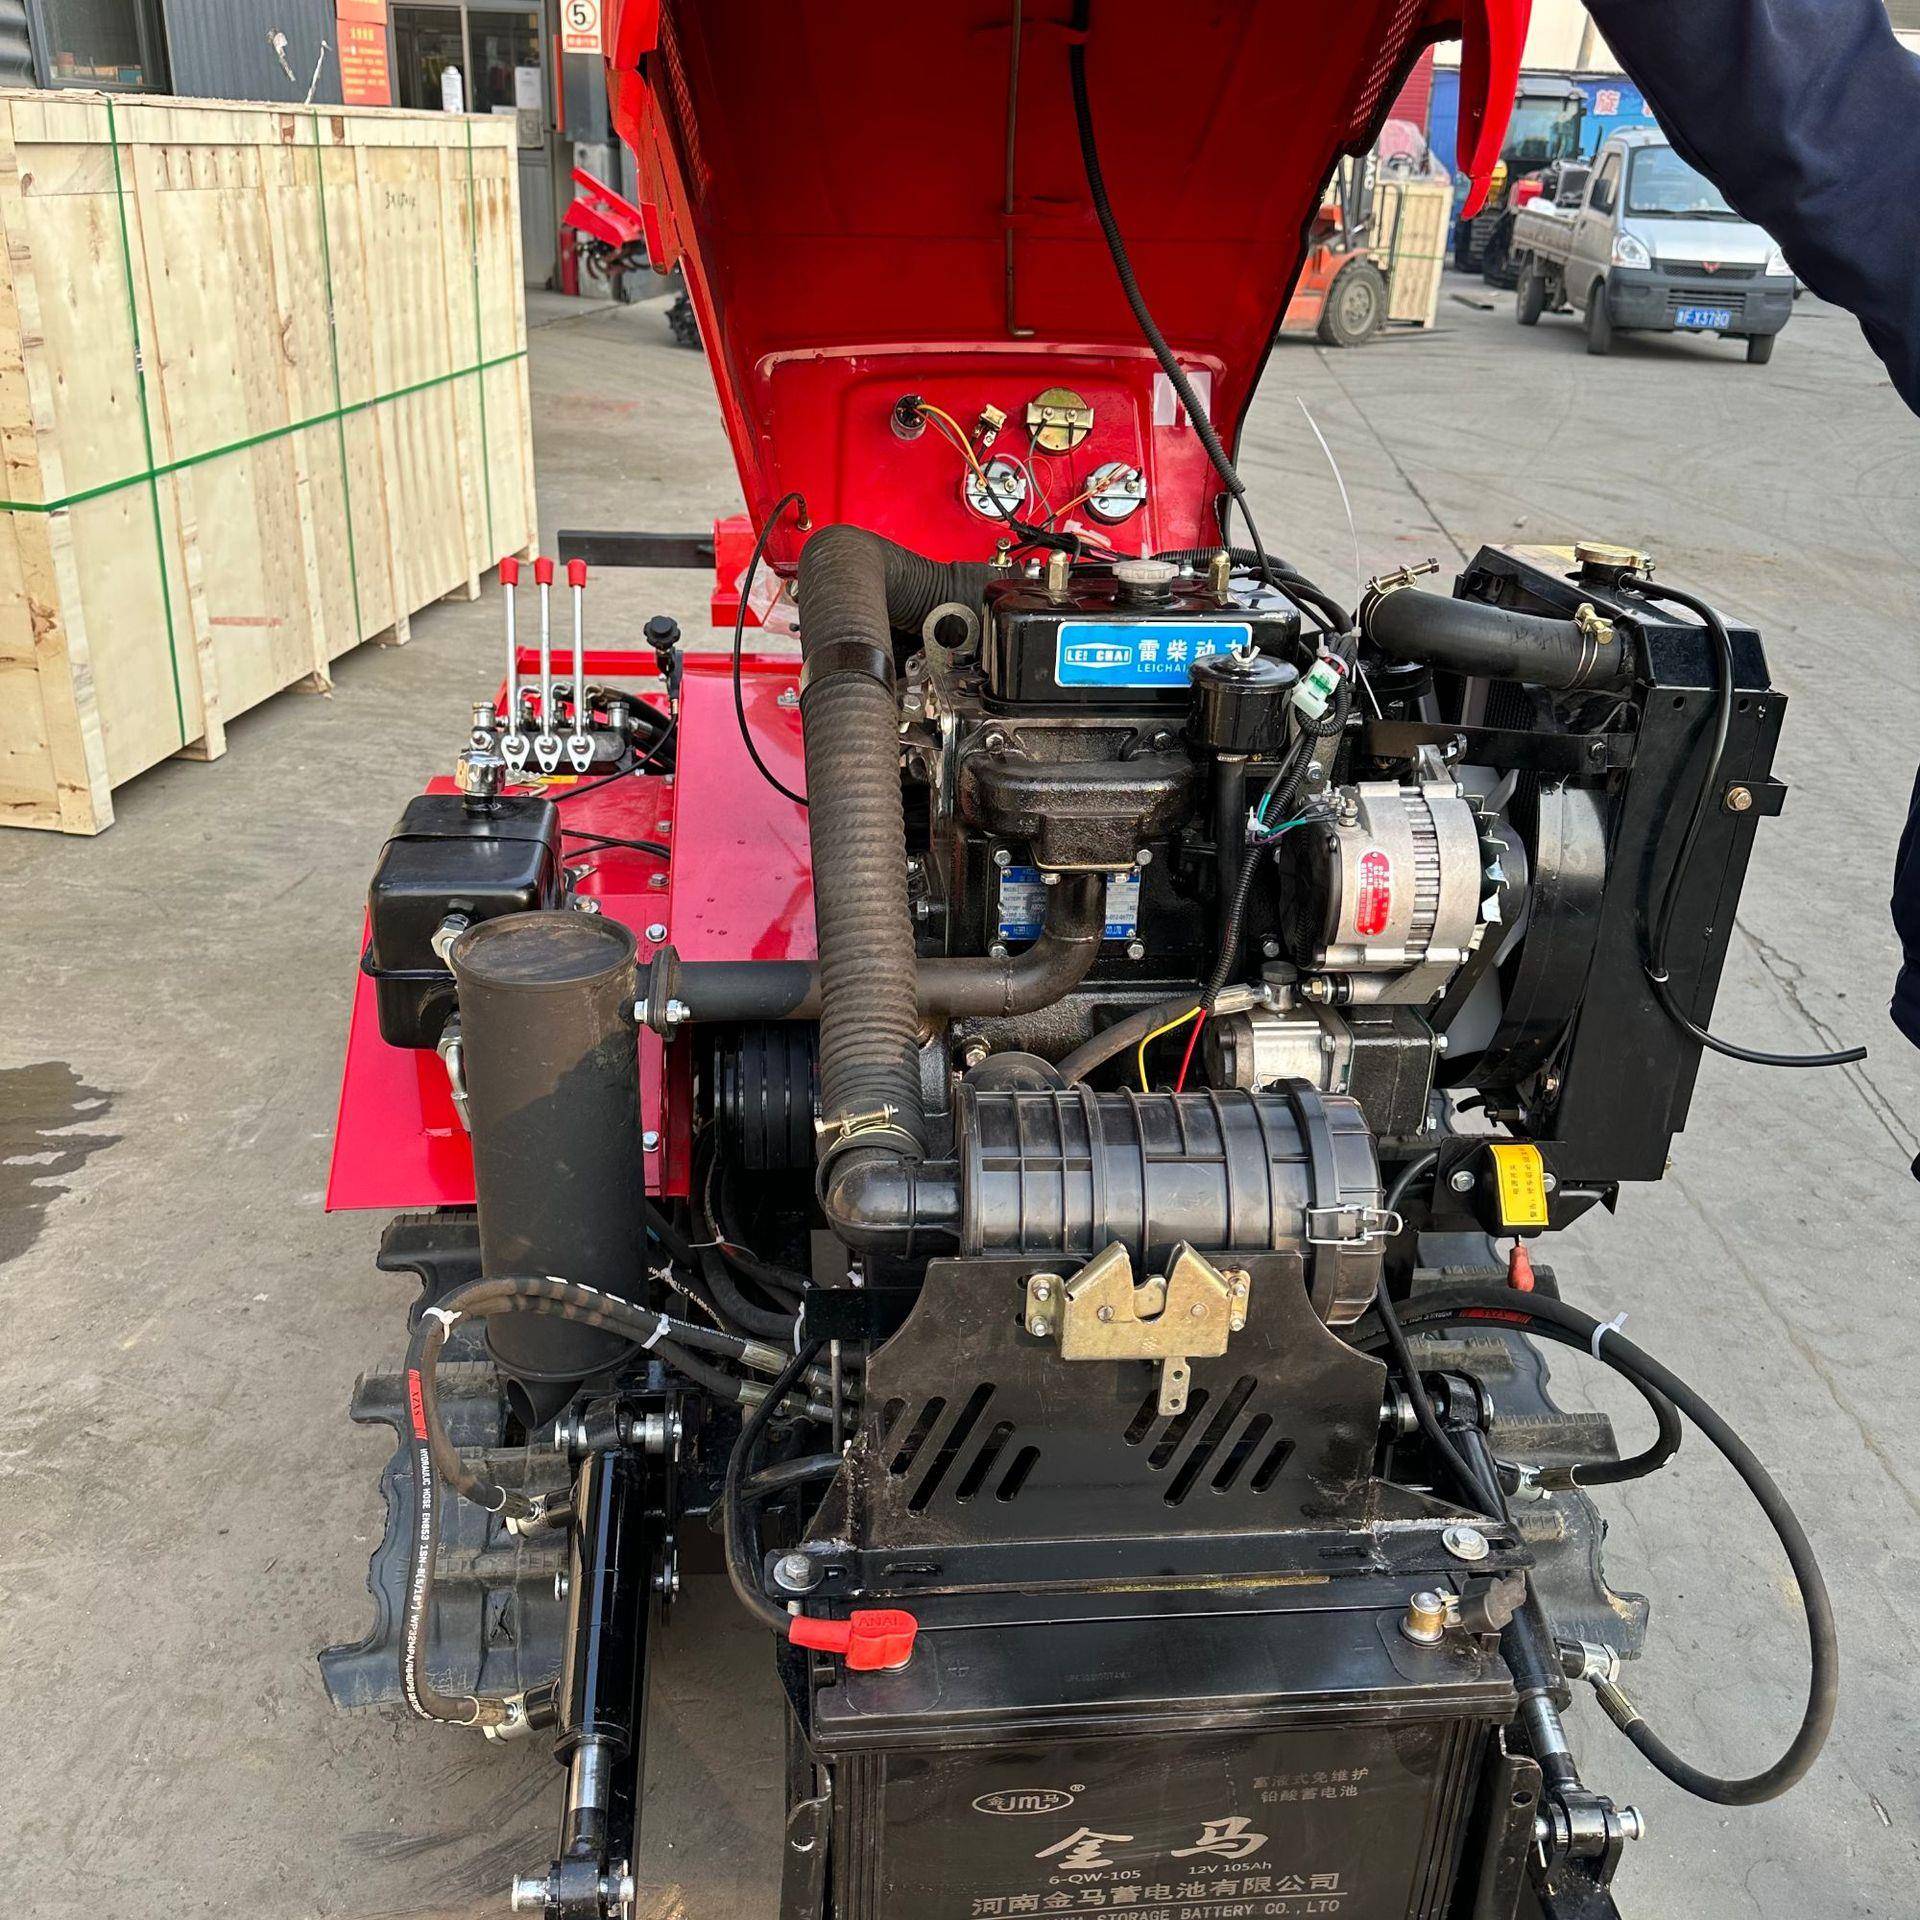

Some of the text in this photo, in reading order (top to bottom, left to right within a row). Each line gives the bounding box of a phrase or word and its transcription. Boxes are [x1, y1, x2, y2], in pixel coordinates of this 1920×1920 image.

[573, 4, 586, 25] 5
[1096, 649, 1129, 661] CHAI
[419, 1448, 431, 1486] HYDRAULIC
[422, 1487, 432, 1509] HOSE
[420, 1513, 432, 1541] EN853
[1261, 1785, 1359, 1804] 铅酸蓄电池
[1049, 1870, 1142, 1885] 6-QW-105
[1188, 1861, 1272, 1875] 12V 105Ah
[971, 1873, 1340, 1916] 河南金马蓄电池有限公司
[1180, 1904, 1255, 1920] BATTERY
